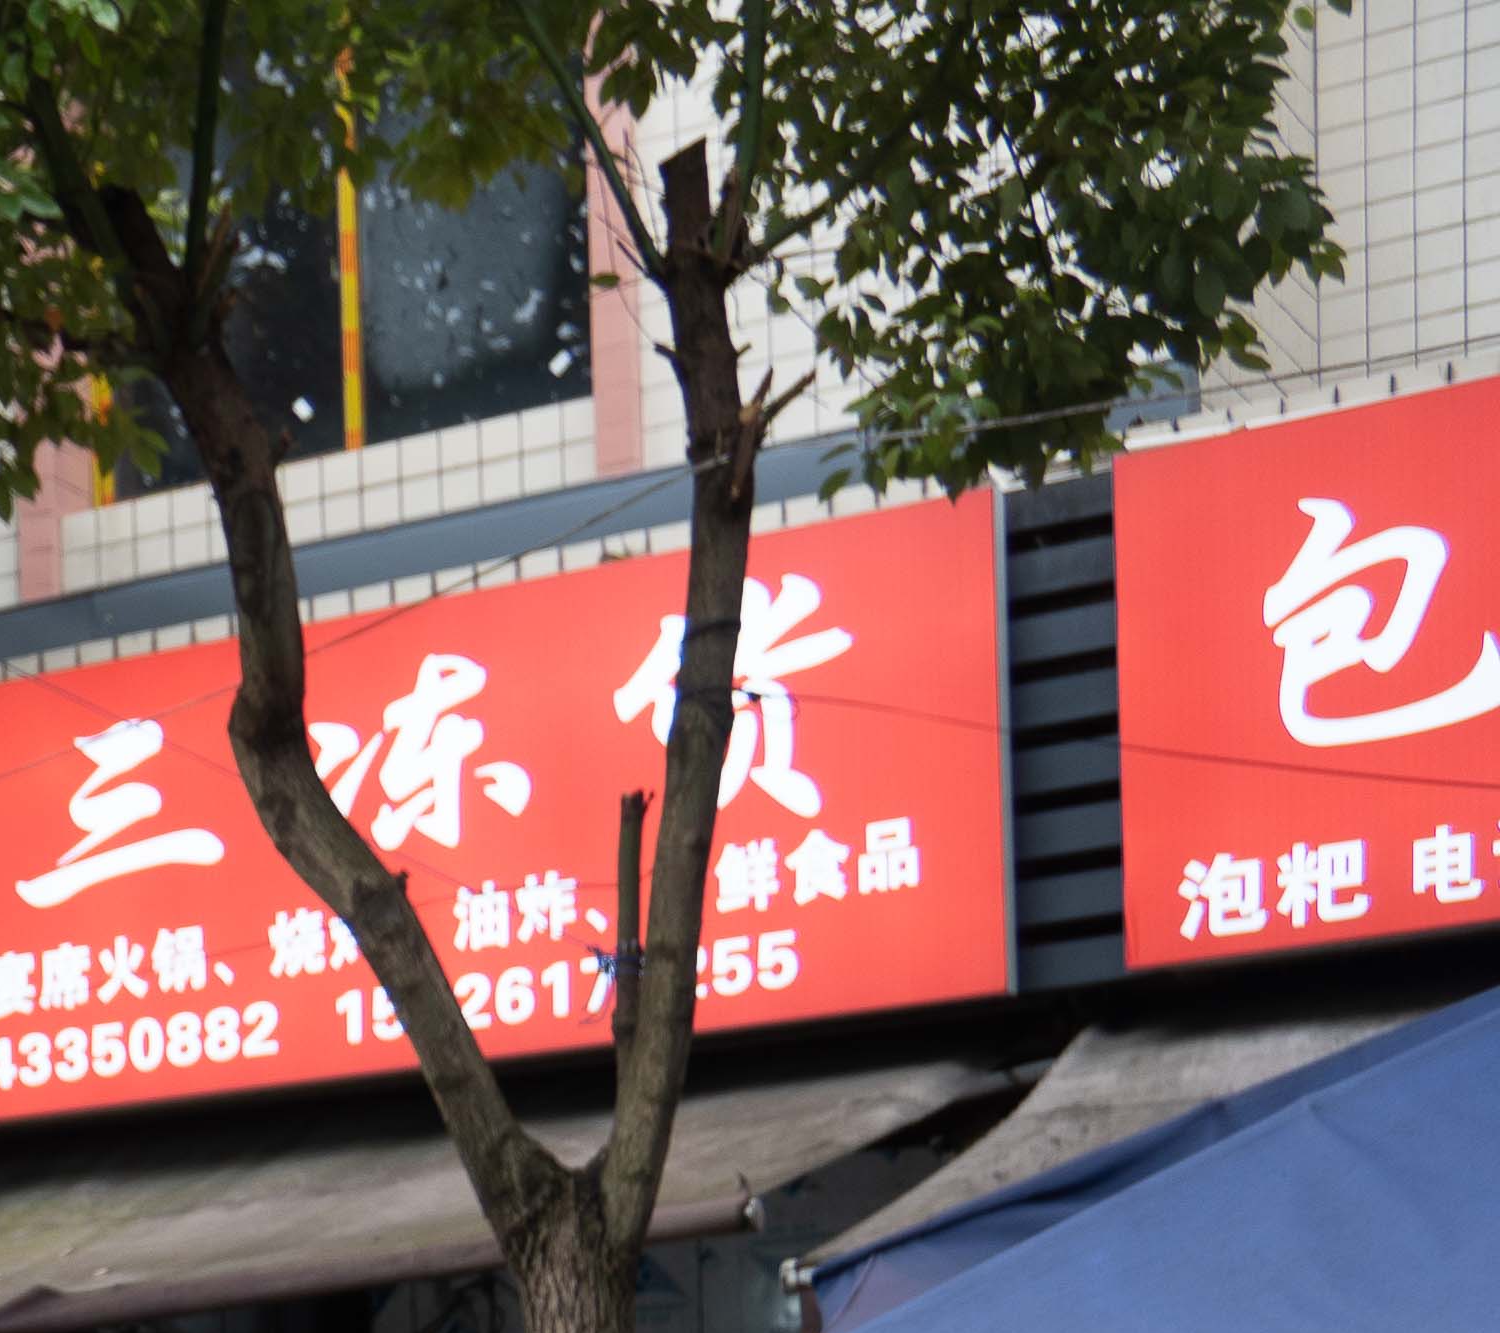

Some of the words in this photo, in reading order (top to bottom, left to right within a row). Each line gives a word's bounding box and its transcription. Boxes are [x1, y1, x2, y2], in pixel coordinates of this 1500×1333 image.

[1178, 837, 1372, 941] 泡粑
[1412, 818, 1500, 905] 电
[335, 929, 800, 1046] 15261755
